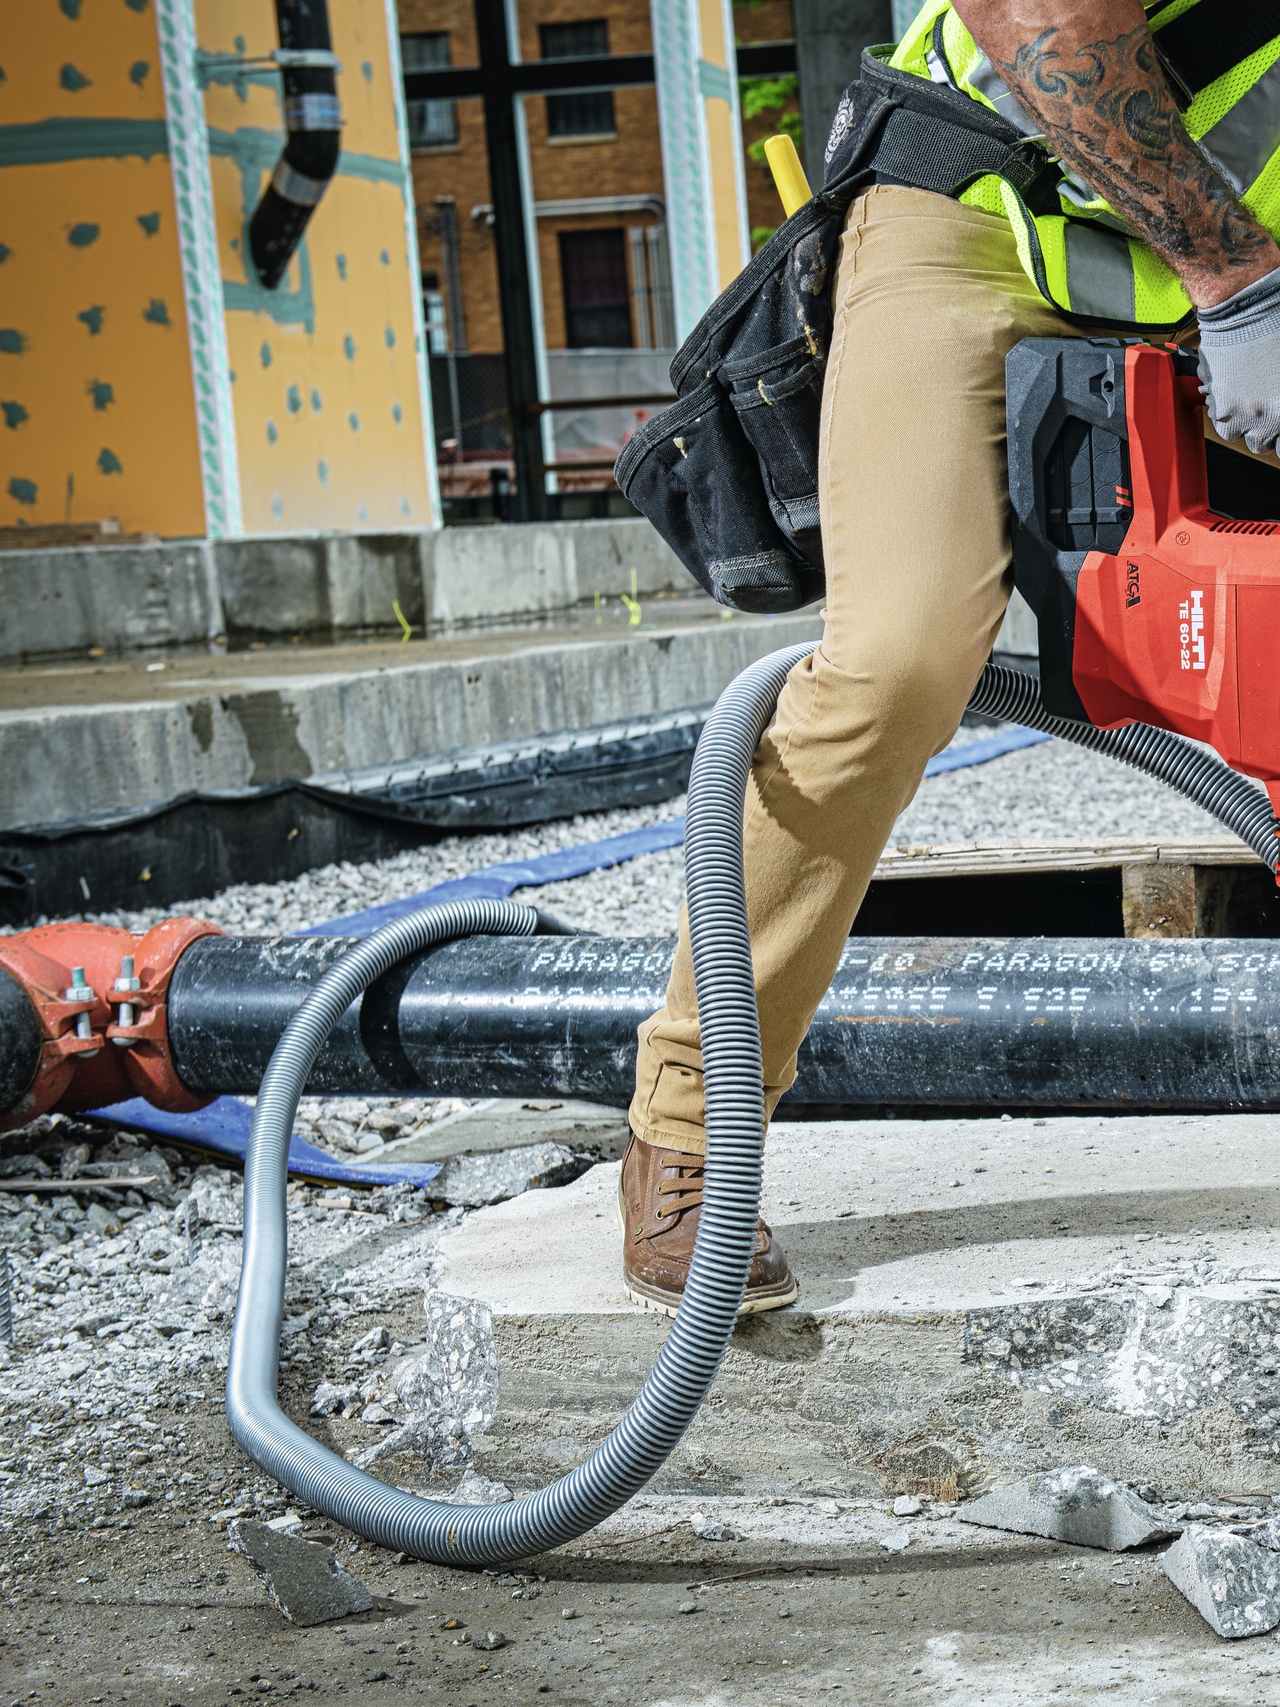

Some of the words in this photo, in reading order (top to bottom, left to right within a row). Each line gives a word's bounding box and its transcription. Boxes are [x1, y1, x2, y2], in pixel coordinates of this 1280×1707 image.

[1179, 600, 1189, 619] TE
[1190, 590, 1205, 669] HILTI
[1179, 623, 1190, 670] 60-22
[960, 953, 1125, 972] PARAGON
